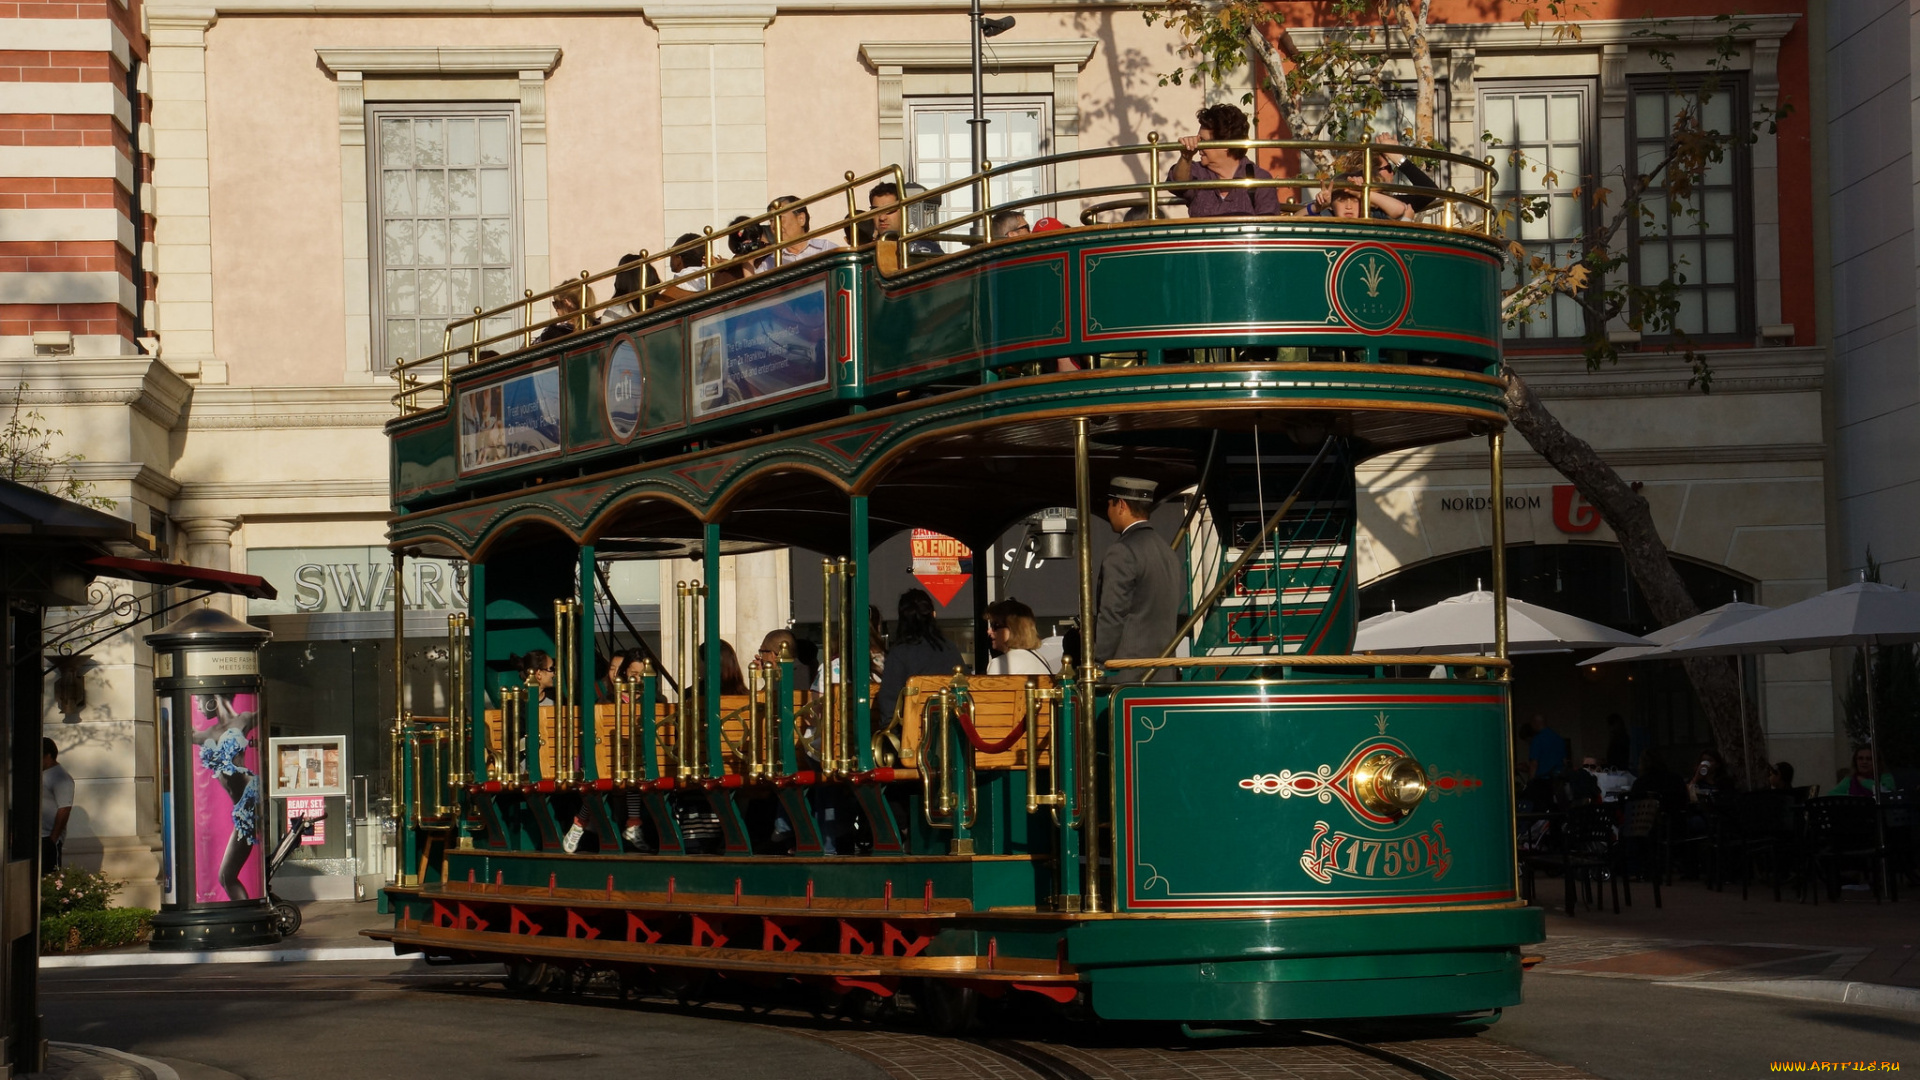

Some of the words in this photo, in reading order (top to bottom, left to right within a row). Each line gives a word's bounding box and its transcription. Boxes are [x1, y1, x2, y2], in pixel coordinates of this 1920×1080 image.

[614, 375, 632, 402] citi
[1440, 496, 1541, 511] NORDSROM
[913, 539, 970, 557] BLENDED
[1343, 838, 1420, 876] 1759
